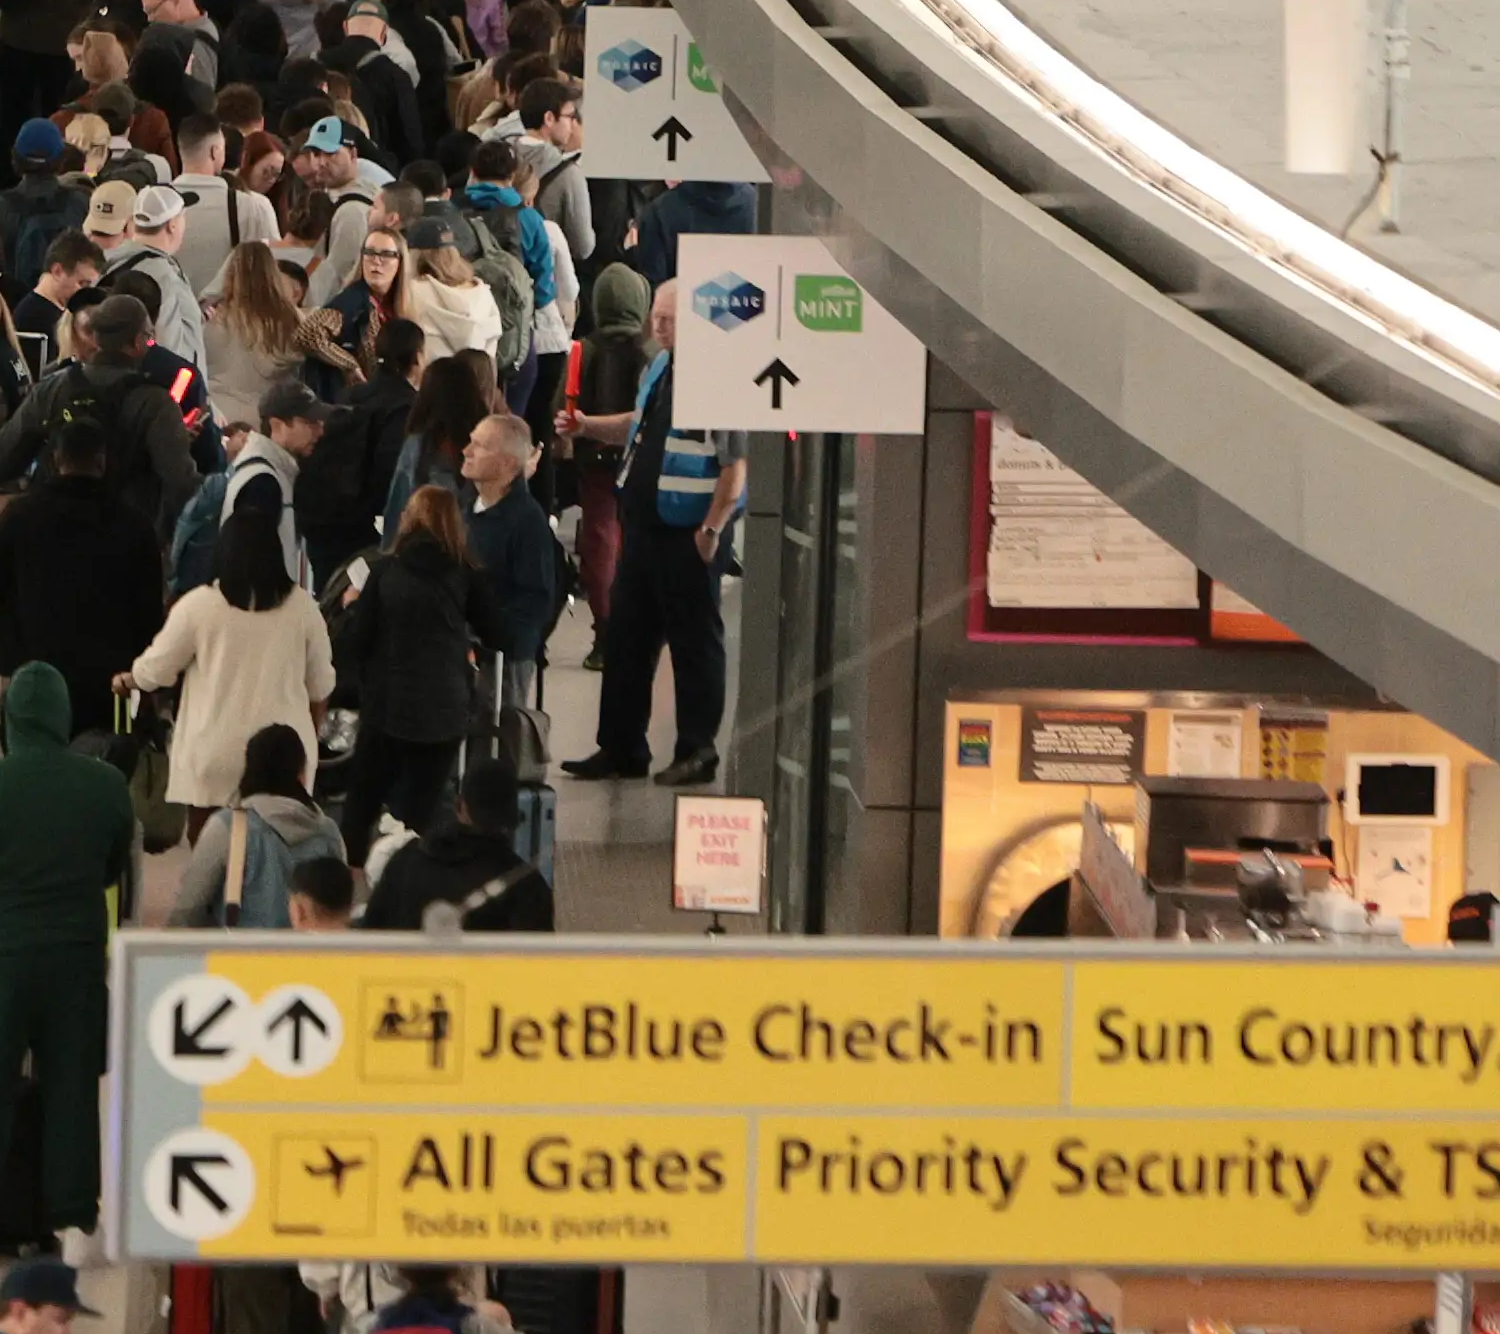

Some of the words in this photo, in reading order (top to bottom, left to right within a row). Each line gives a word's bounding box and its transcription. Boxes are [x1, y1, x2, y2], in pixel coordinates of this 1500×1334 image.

[696, 295, 762, 310] MOSAIC
[799, 299, 859, 319] MINT
[477, 1002, 726, 1062] JetBlue
[751, 1002, 1044, 1063] Check-in
[1096, 1007, 1214, 1064] Sun
[1238, 1007, 1500, 1085] Country
[401, 1132, 495, 1194] All
[522, 1135, 727, 1195] Gates
[774, 1135, 1027, 1213] Priority
[1051, 1138, 1332, 1216] Security
[1356, 1140, 1404, 1199] &
[1430, 1140, 1500, 1201] TS
[401, 1211, 489, 1238] Todas
[499, 1212, 543, 1238] las
[551, 1214, 671, 1245] puertas
